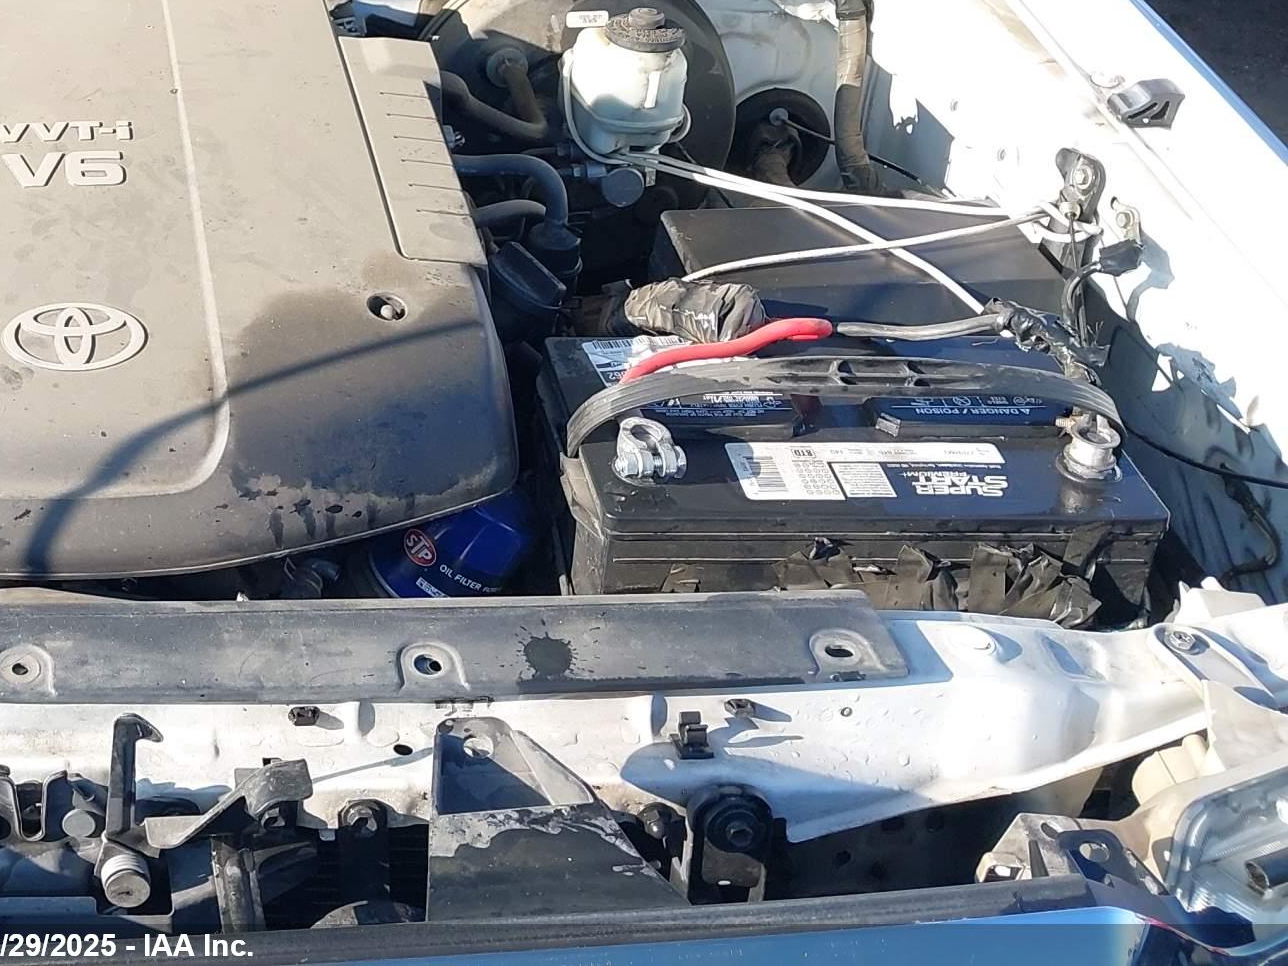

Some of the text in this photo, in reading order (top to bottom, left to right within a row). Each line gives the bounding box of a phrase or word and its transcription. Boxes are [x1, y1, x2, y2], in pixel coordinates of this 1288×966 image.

[1, 149, 128, 188] V6
[916, 407, 960, 415] POISON
[971, 407, 1020, 415] DANGER
[911, 475, 1008, 489] START
[915, 484, 1004, 497] SUPER
[406, 534, 433, 560] STP
[439, 564, 453, 578] OIL
[454, 574, 482, 591] FILTER
